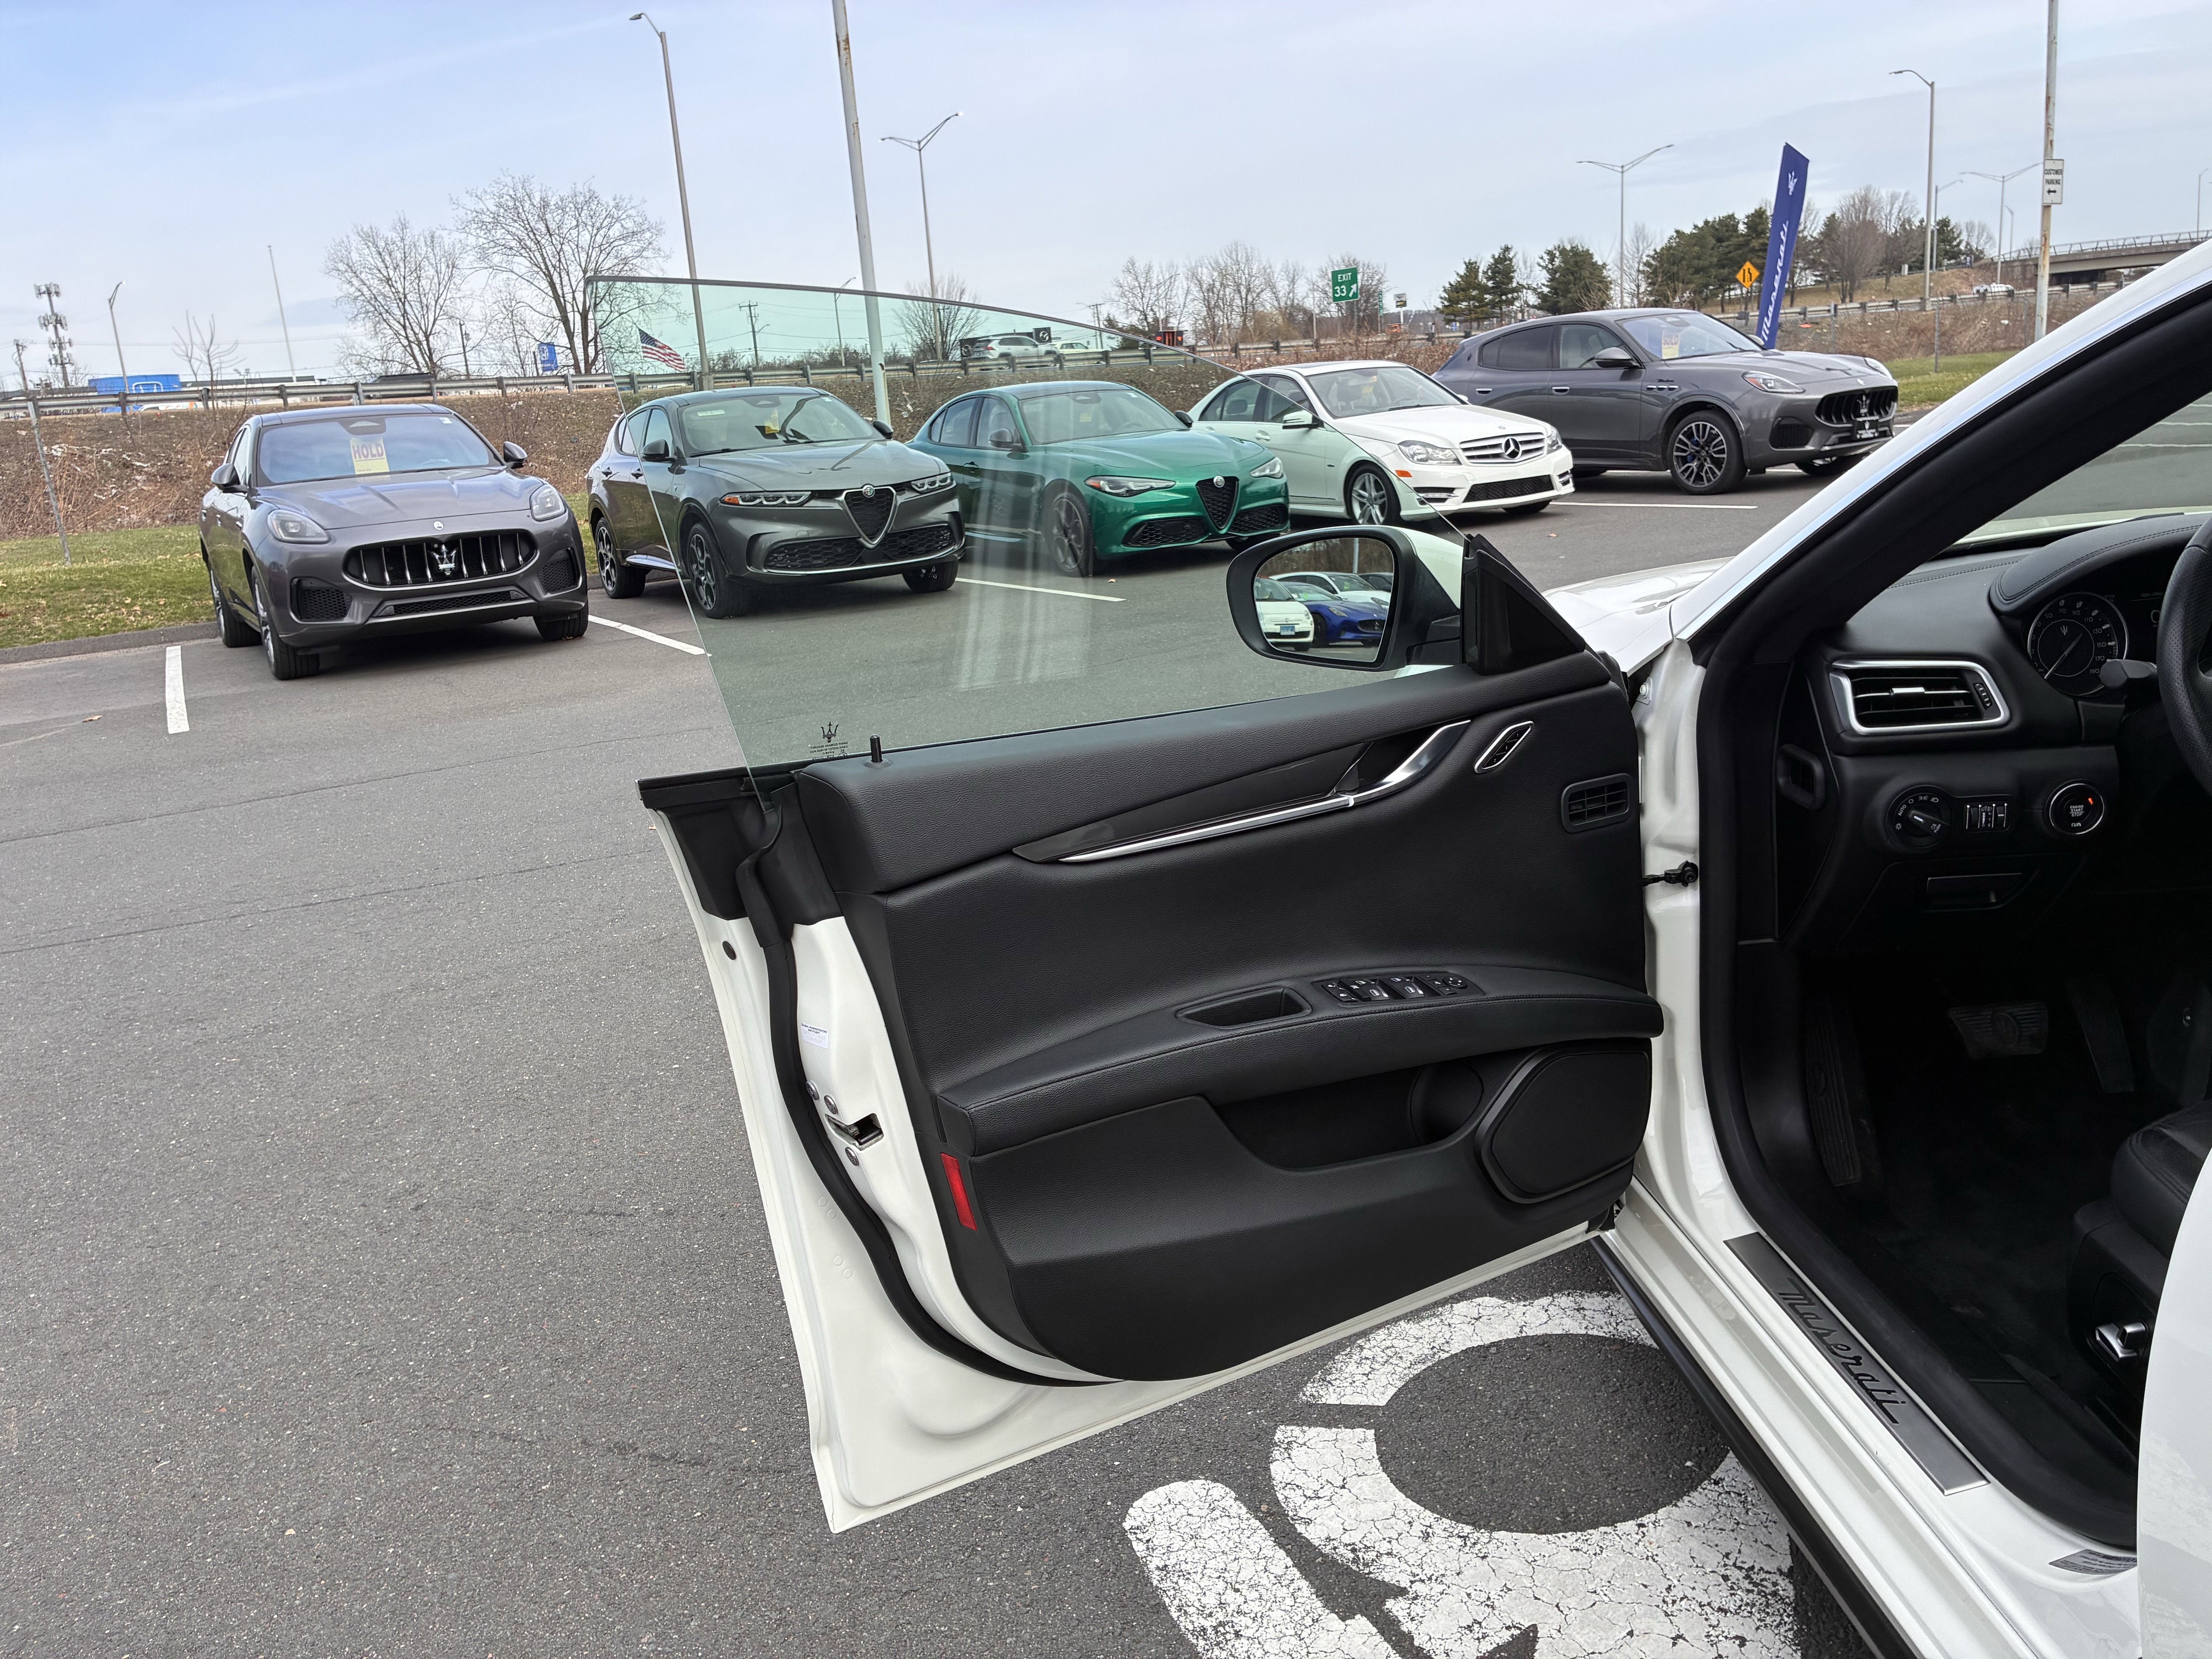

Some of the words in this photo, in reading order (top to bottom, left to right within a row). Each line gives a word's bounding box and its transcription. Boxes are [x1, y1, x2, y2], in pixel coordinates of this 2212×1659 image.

[1338, 273, 1352, 282] EXIT
[1334, 285, 1346, 297] 33
[352, 444, 384, 459] HOLD
[1898, 804, 1907, 816] AUTO
[1778, 1277, 1906, 1424] Maserati
